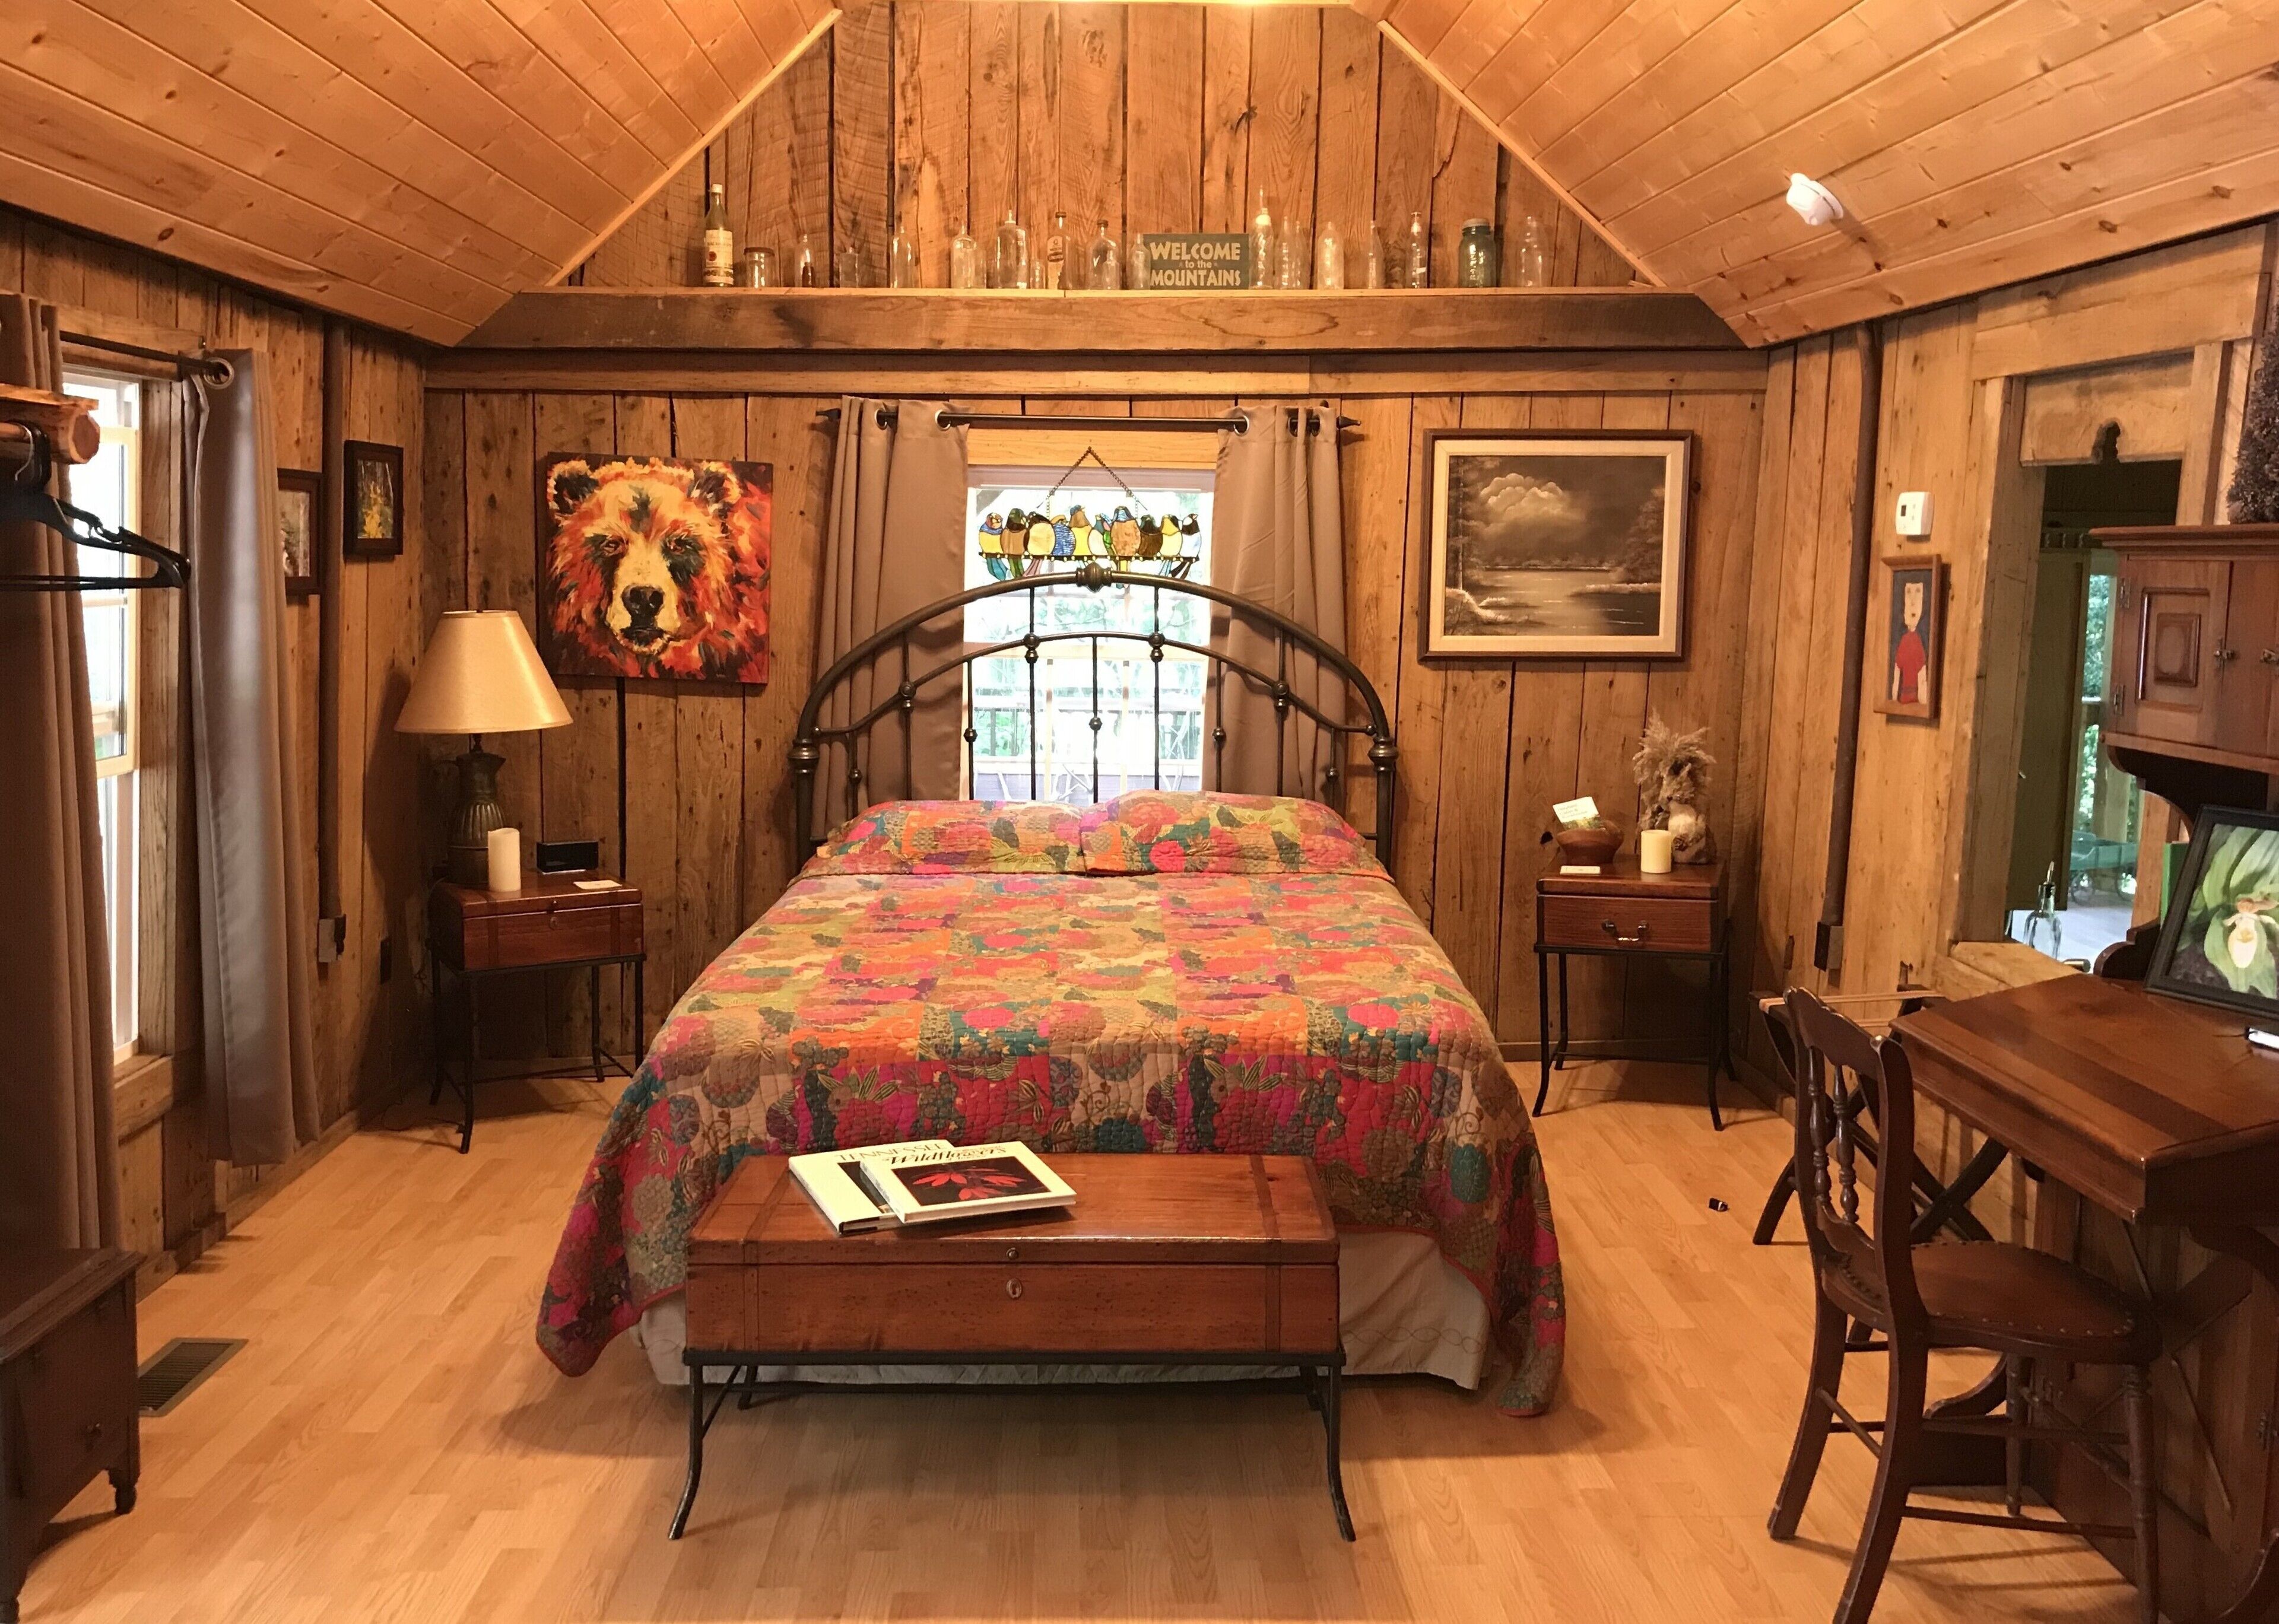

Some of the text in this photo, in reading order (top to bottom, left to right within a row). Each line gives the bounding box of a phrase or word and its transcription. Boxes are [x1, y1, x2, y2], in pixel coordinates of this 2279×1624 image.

[1150, 241, 1241, 260] WELCOME
[1185, 259, 1212, 268] to the
[1150, 269, 1242, 287] MOUNTAINS
[835, 1143, 945, 1161] TENNESSEE
[891, 1148, 1007, 1165] Wildflowers
